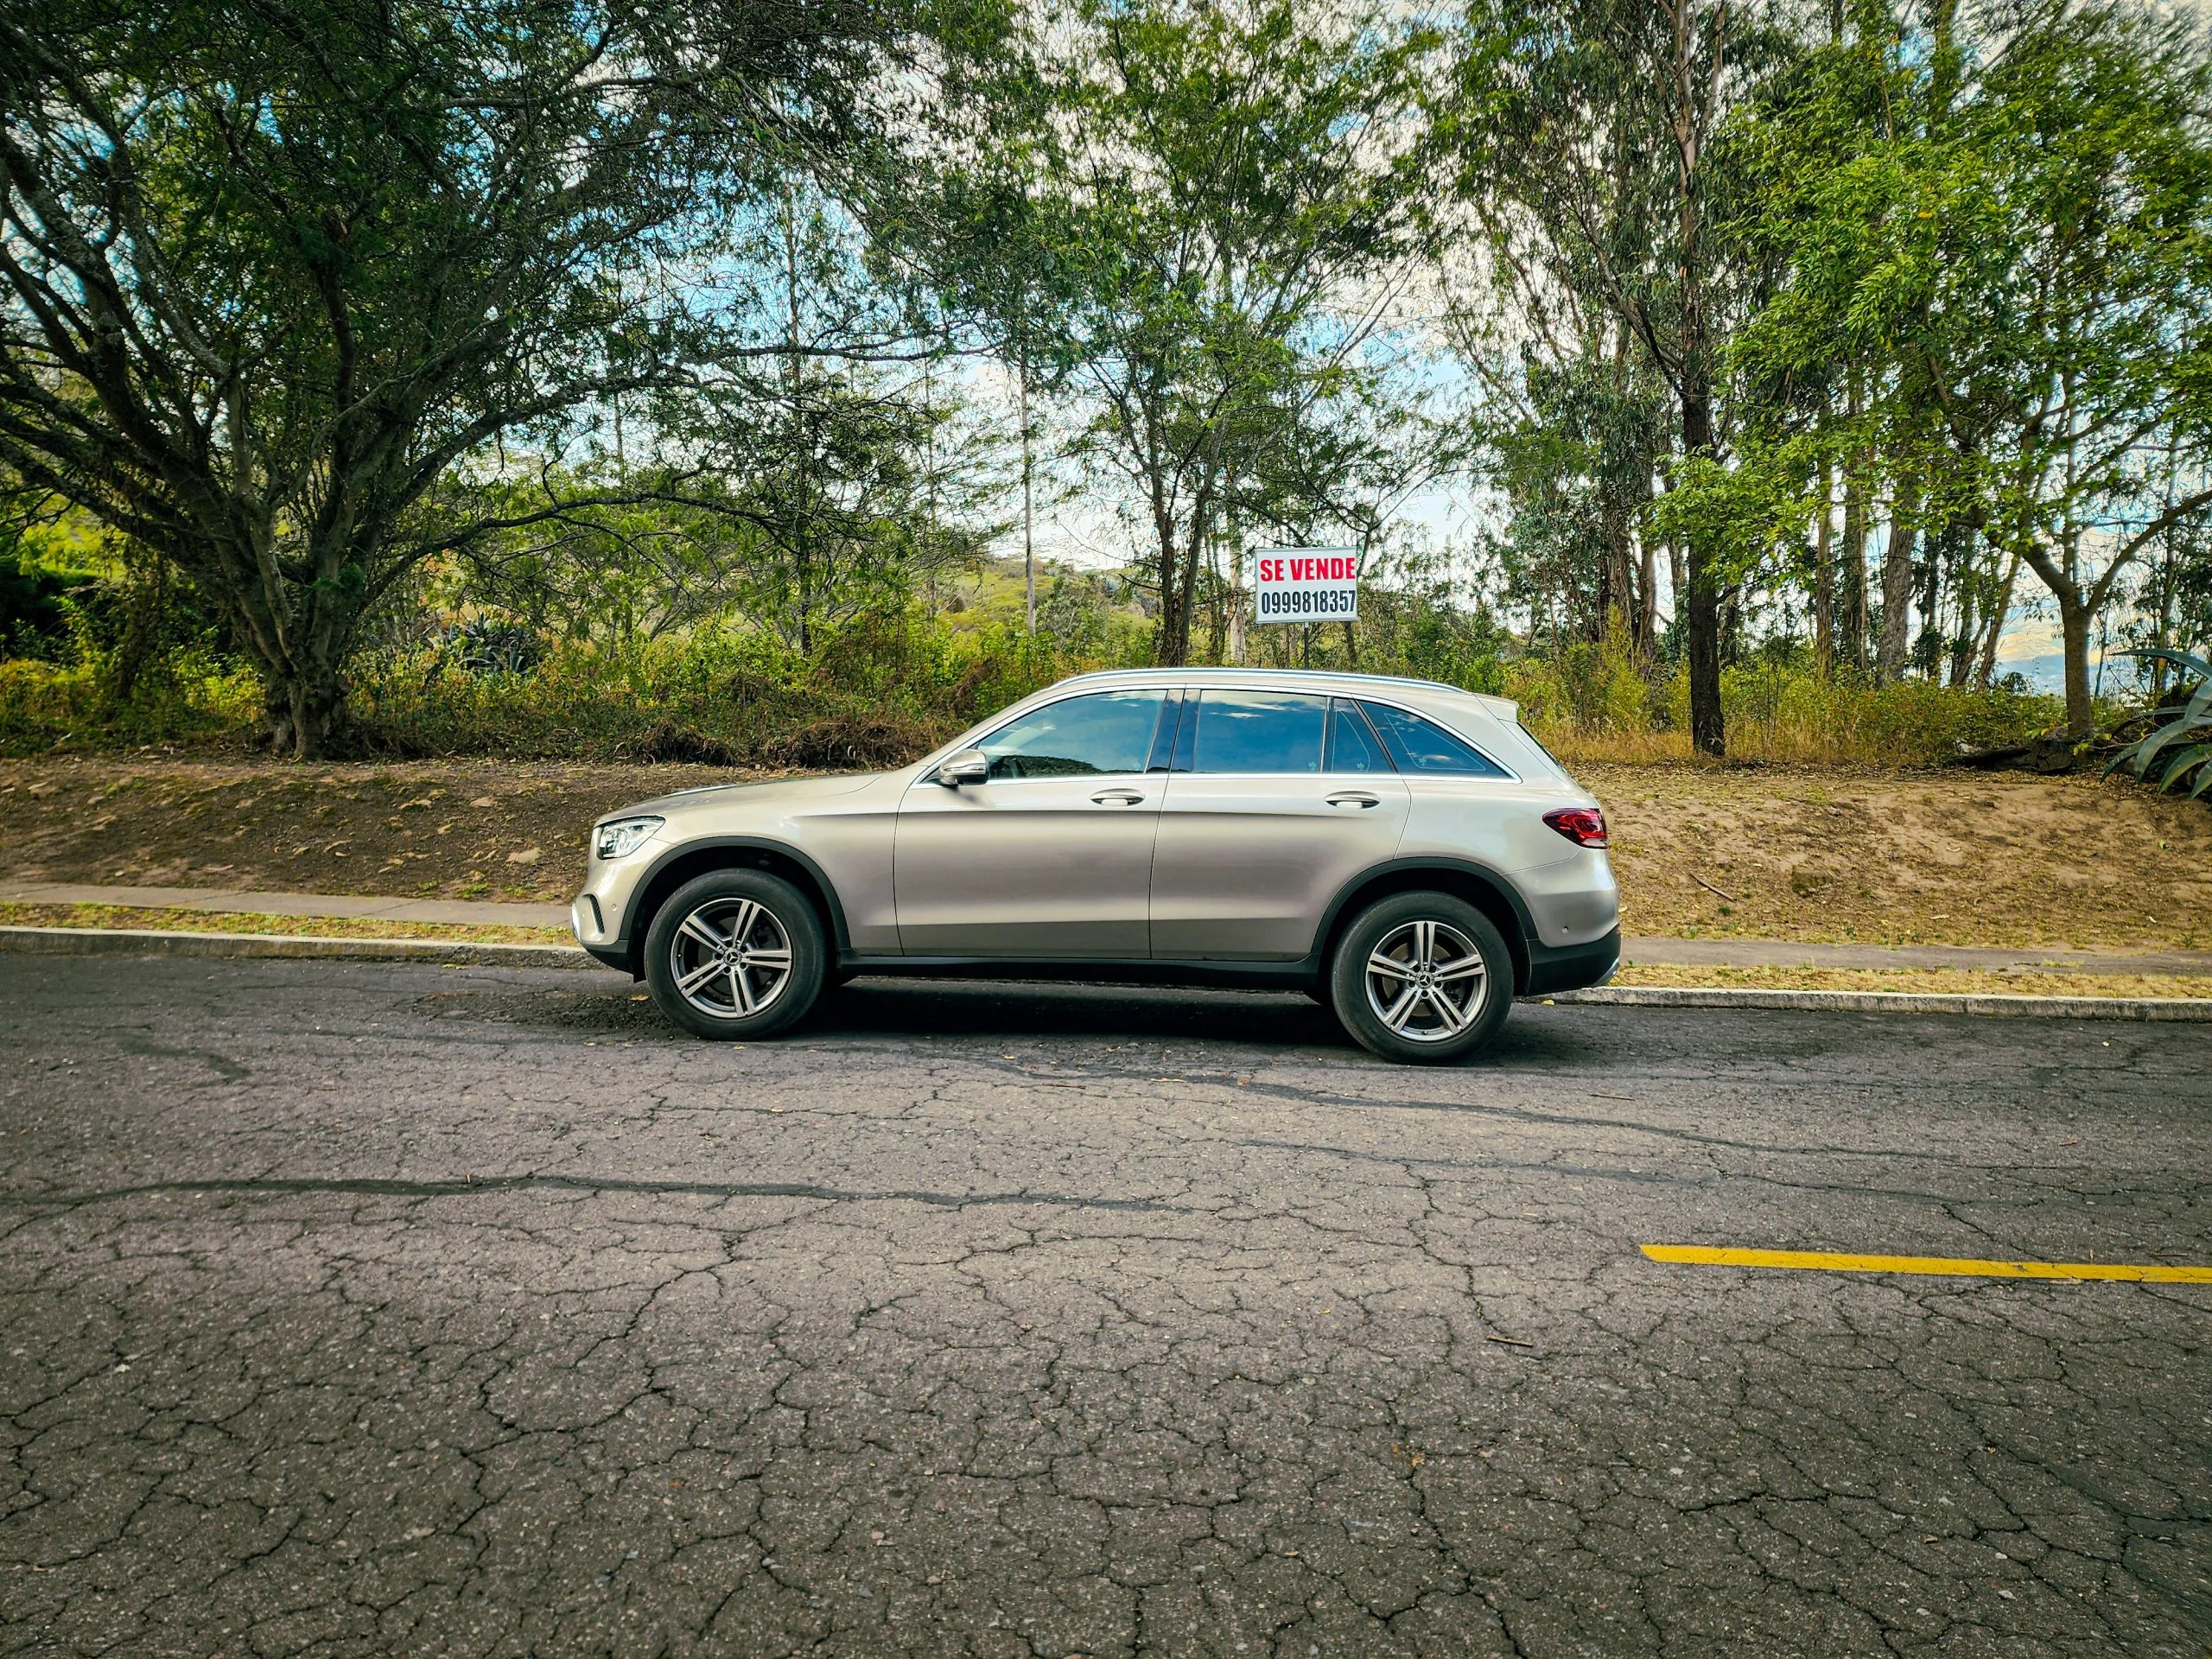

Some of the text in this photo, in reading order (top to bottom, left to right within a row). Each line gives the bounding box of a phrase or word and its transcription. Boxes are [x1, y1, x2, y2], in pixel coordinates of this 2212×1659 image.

[1260, 557, 1356, 582] SE VENDE
[1262, 590, 1356, 614] 0999818357
